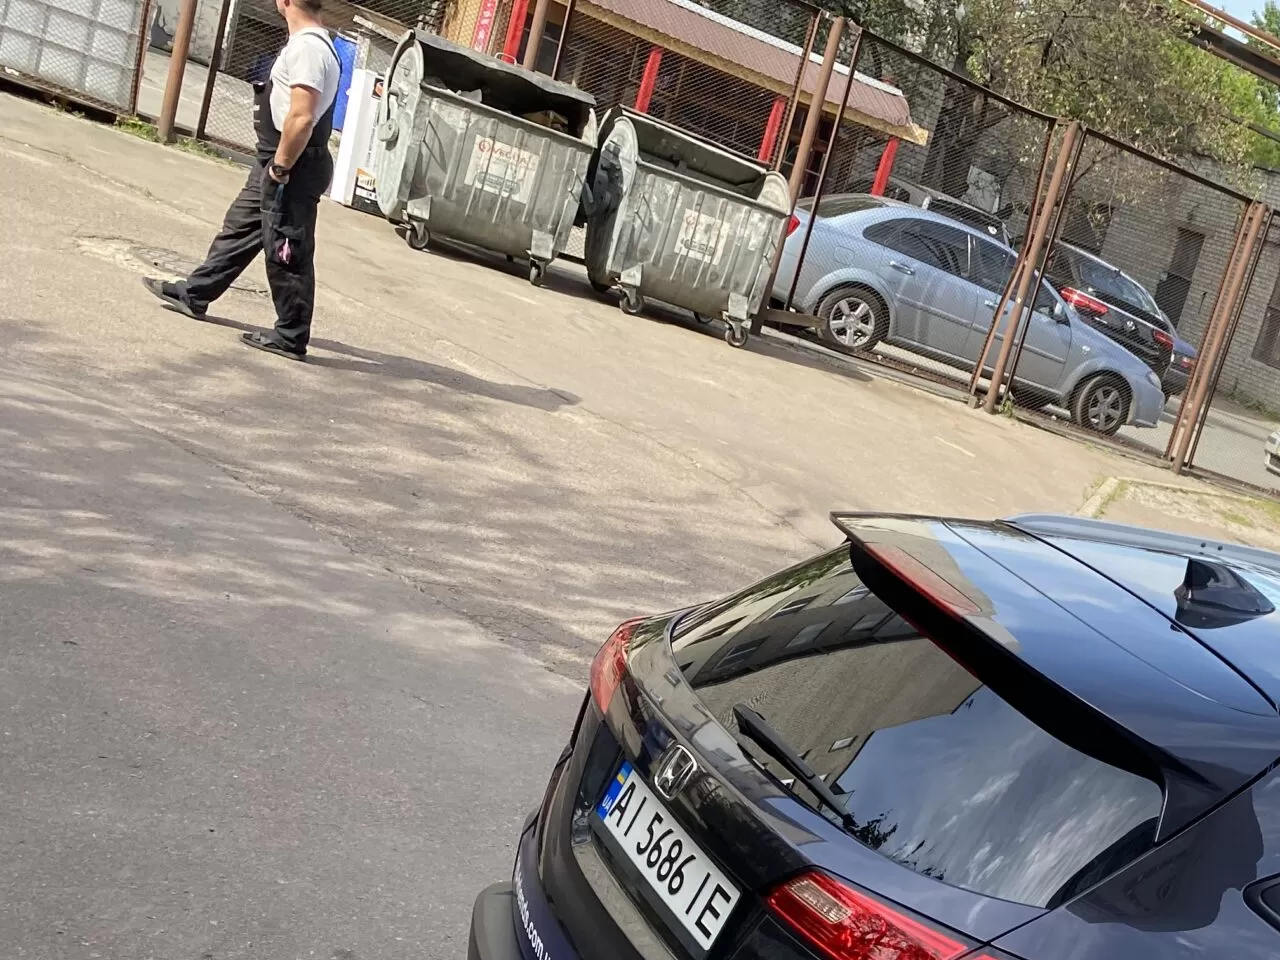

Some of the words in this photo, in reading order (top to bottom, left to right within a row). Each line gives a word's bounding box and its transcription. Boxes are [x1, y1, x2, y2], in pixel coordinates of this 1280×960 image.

[602, 794, 613, 811] UA
[609, 781, 647, 837] AI
[636, 811, 697, 896] 5686
[685, 872, 732, 941] IE
